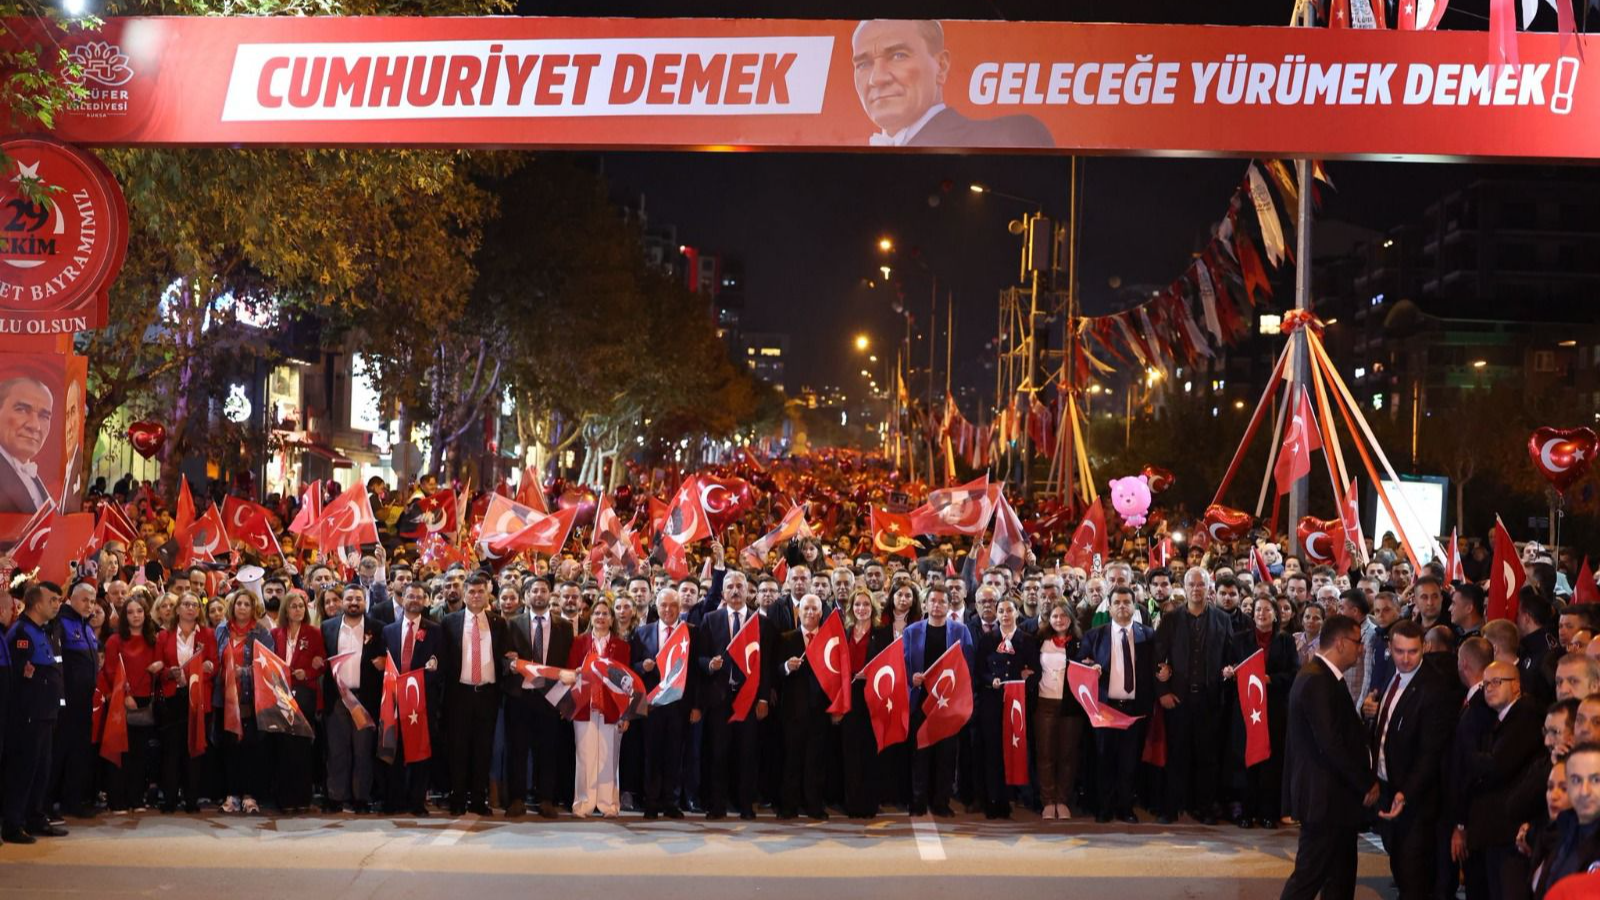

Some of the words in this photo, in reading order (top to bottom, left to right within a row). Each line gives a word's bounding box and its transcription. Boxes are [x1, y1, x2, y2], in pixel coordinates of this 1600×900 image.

[256, 44, 602, 108] CUMHURİYET
[608, 53, 798, 105] DEMEK
[968, 54, 1181, 105] GELECEĞE
[1191, 54, 1398, 105] YÜRÜMEK
[1403, 56, 1580, 115] DEMEK!
[66, 88, 129, 100] NÜFER
[66, 101, 128, 111] LEDİYESİ
[4, 198, 49, 232] 29
[30, 188, 96, 301] BAYRAMIMIZ
[26, 316, 87, 334] OLSUN
